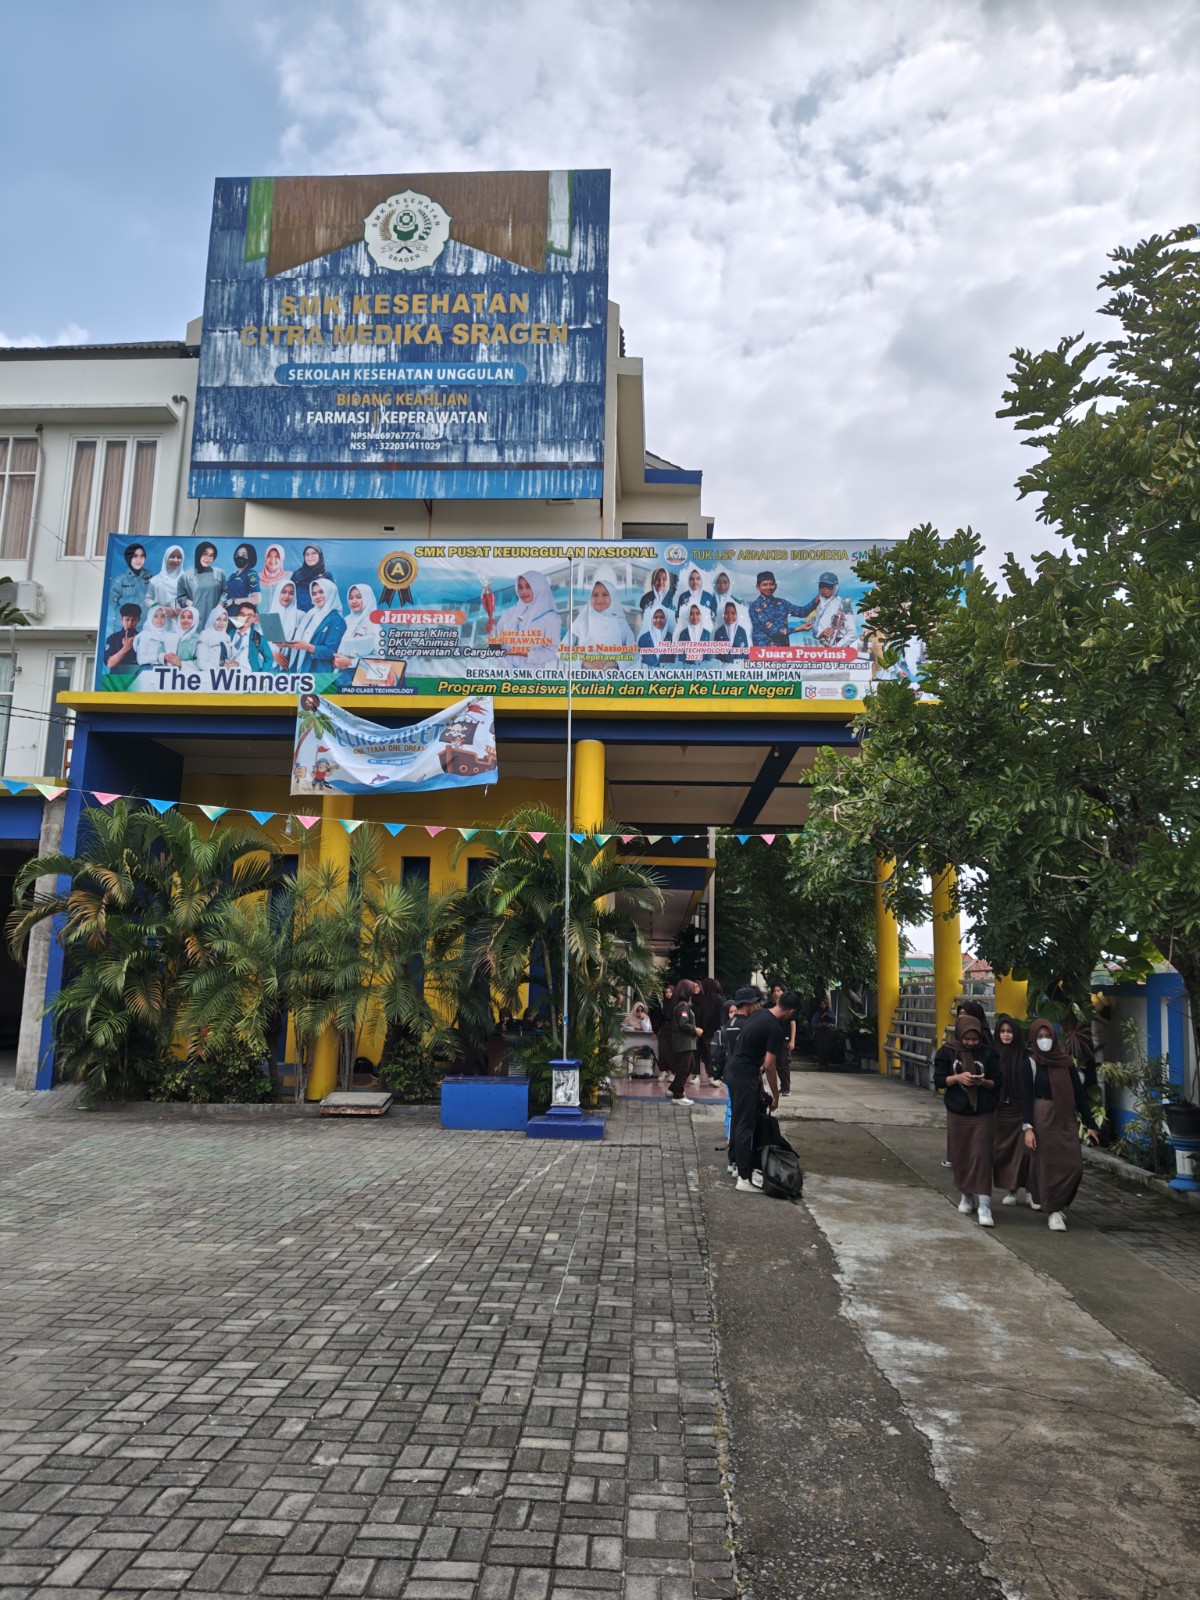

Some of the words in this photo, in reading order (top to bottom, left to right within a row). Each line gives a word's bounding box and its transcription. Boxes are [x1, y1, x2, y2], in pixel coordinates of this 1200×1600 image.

[372, 208, 386, 228] SMK
[388, 197, 440, 227] KESEHATAN
[388, 253, 421, 264] SRAGEN
[280, 294, 341, 316] SMK
[353, 292, 529, 315] KESEHATAN
[240, 324, 324, 347] CITRA
[333, 323, 443, 346] MEDIKA
[452, 322, 568, 346] SRAGEN
[288, 368, 350, 381] SEKOLAH
[354, 368, 433, 381] KESEHATAN
[437, 367, 514, 381] UNGGULAN
[337, 393, 392, 406] BIDANG
[396, 392, 468, 406] KEAHLIAN
[306, 411, 370, 424] FARMASI
[381, 410, 488, 424] KEPERAWATAN
[351, 432, 373, 440] NPSN
[350, 442, 366, 450] NSS
[415, 546, 446, 558] SMK
[448, 546, 491, 558] PUSAT
[493, 546, 585, 558] KEUNGGULAN
[588, 546, 657, 559] NASIONAL
[692, 550, 713, 560] TUK
[715, 550, 735, 560] LSP
[737, 549, 788, 561] ASNAKES
[791, 549, 849, 560] INDONESIA
[390, 562, 406, 576] A
[380, 610, 456, 624] Jurusan
[388, 629, 428, 638] Farmasi
[429, 629, 458, 638] Klinis
[388, 638, 411, 647] DKV
[418, 638, 458, 647] Animasi
[588, 645, 594, 653] 2
[596, 644, 638, 653] Nasional
[387, 648, 451, 657] Keperawatan
[453, 648, 461, 657] &
[463, 648, 506, 658] Cargiver
[580, 654, 634, 662] Keperawatan
[757, 647, 793, 659] Juara
[795, 647, 847, 659] Provinsi
[744, 661, 762, 669] LKS
[764, 661, 822, 670] Keperawatan
[833, 661, 869, 670] Farmasi
[155, 668, 201, 690] The
[210, 668, 314, 692] Winners
[466, 669, 510, 679] BERSAMA
[513, 669, 534, 679] SMK
[536, 669, 564, 679] CITRA
[568, 670, 604, 679] MEDIKA
[606, 670, 644, 680] SRAGEN
[648, 670, 693, 680] LANGKAH
[696, 670, 723, 680] PASTI
[726, 670, 763, 680] MERAIH
[766, 670, 801, 680] IMPIAN
[438, 681, 497, 697] Program
[500, 682, 567, 695] Beasiswa
[570, 683, 615, 695] Kuliah
[618, 684, 644, 695] dan
[648, 683, 685, 698] Kerja
[689, 683, 708, 695] Ke
[711, 683, 745, 695] Luar
[747, 683, 795, 696] Negeri
[366, 745, 387, 754] TEAM
[388, 744, 402, 752] ONE
